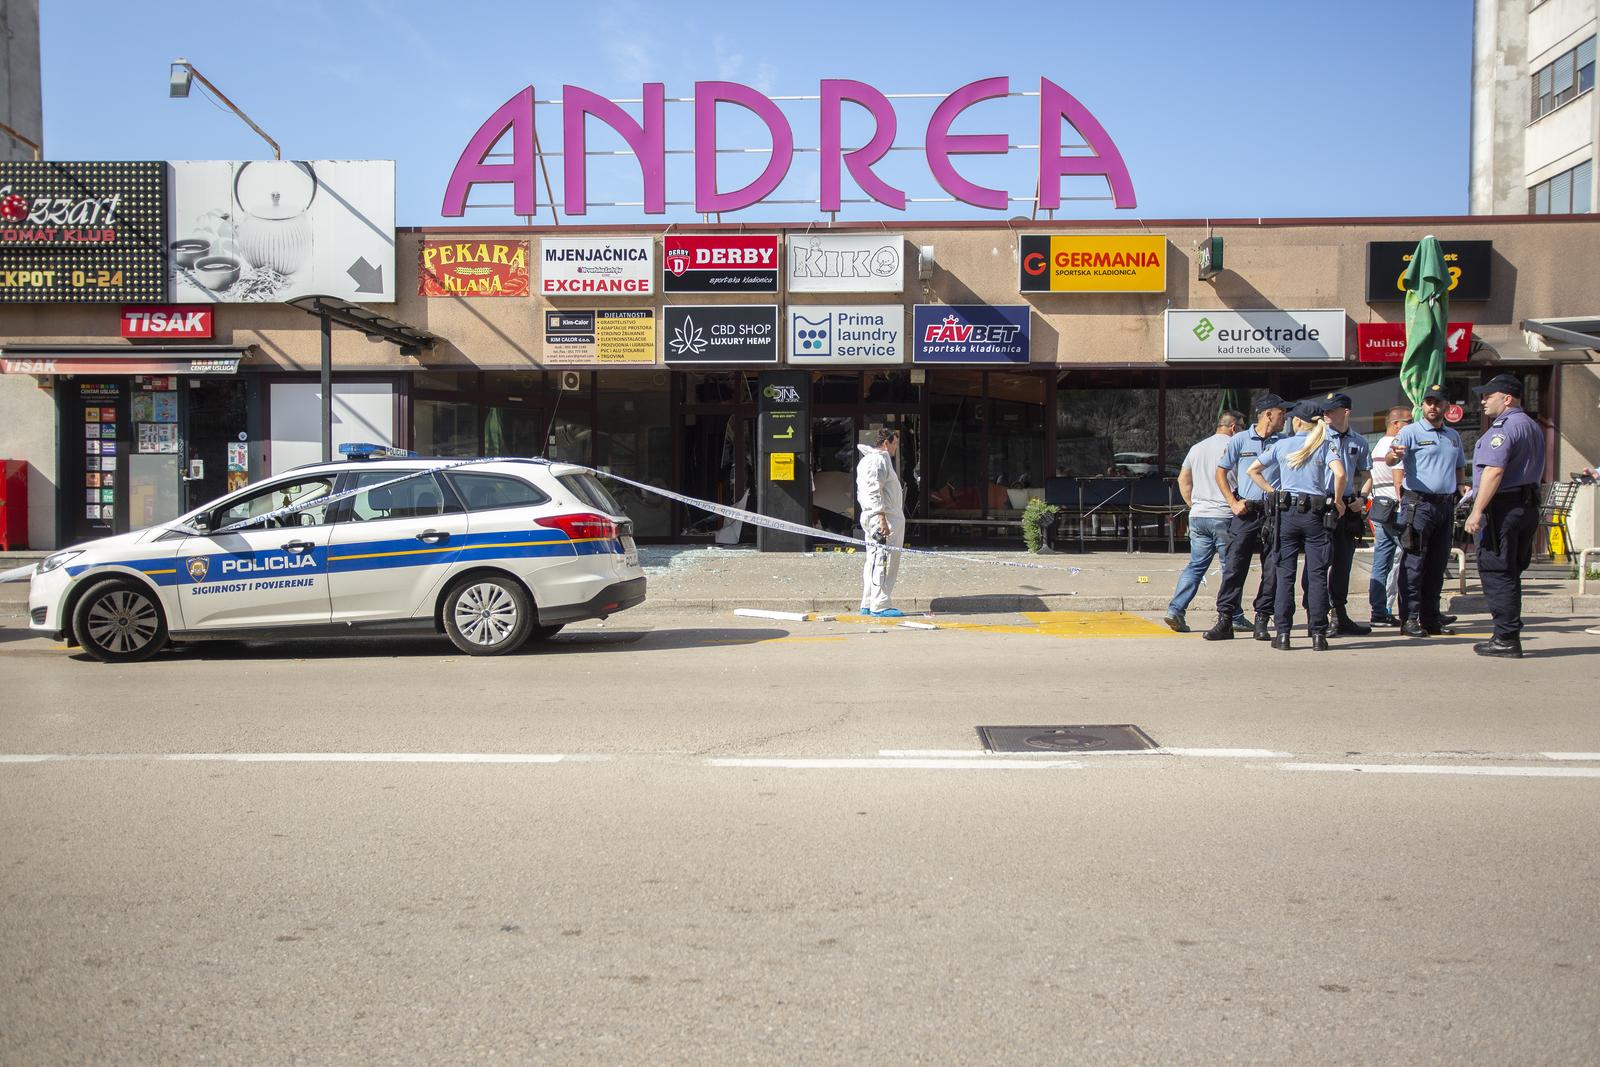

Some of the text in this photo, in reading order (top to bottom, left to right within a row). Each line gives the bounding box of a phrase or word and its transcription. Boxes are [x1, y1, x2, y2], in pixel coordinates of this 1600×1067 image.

[440, 76, 1137, 217] ANDREA
[64, 229, 115, 241] KLUB
[422, 243, 525, 269] PEKARA
[545, 245, 648, 261] MJENJAČNICA
[696, 248, 773, 264] DERBY
[1055, 252, 1160, 268] GERMANIA
[674, 259, 684, 273] D
[72, 271, 122, 287] 0-24
[444, 273, 503, 292] KLANA
[544, 279, 649, 292] EXCHANGE
[709, 276, 773, 285] sportska kladionica
[125, 312, 205, 333] TISAK
[838, 313, 884, 326] Prima
[711, 324, 772, 335] CBD SHOP
[838, 328, 897, 344] laundry
[924, 324, 1020, 343] FAVBET
[1218, 324, 1320, 342] eurotrade
[746, 337, 772, 345] HEMP
[922, 343, 1022, 354] sportska kladionica
[1217, 344, 1292, 354] kad trebate više
[1366, 338, 1405, 348] Julius
[838, 344, 896, 356] service
[5, 359, 58, 373] TISAK
[222, 554, 317, 574] POLICIJA
[191, 583, 247, 595] SIGURNOST
[255, 578, 315, 590] POVJERENJE
